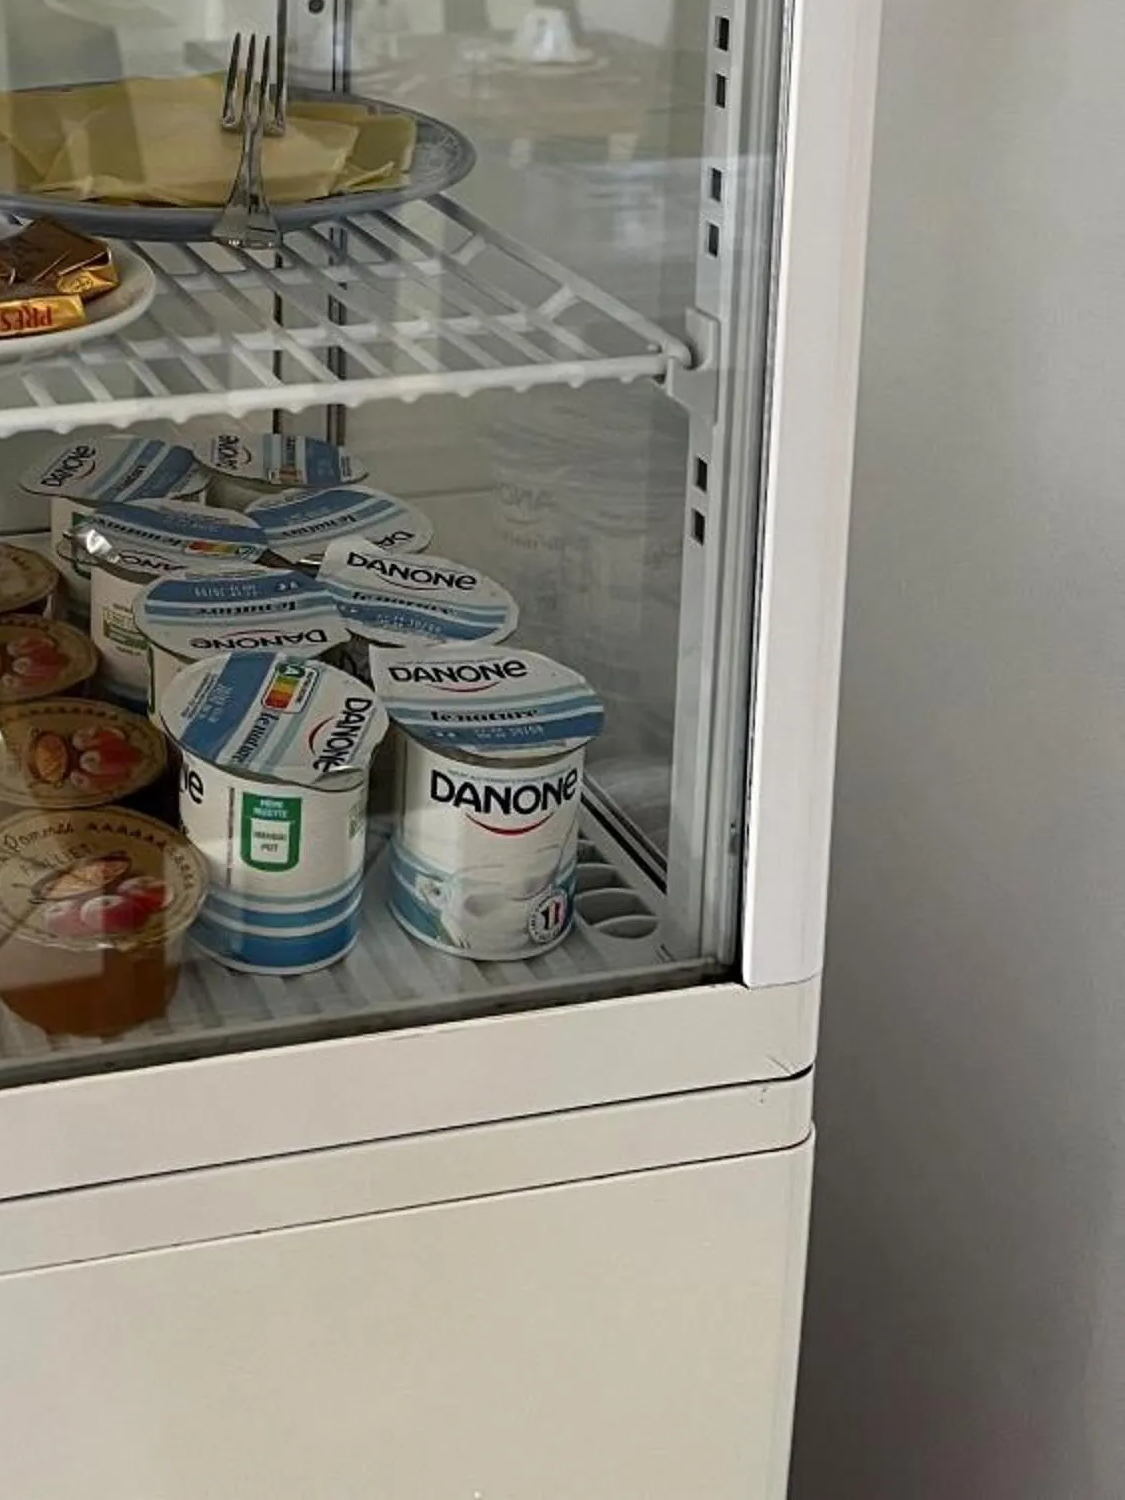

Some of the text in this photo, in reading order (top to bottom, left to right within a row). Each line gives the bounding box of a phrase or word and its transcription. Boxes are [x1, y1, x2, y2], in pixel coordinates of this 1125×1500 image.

[346, 550, 478, 591] DANONE
[190, 629, 328, 650] DANONE
[388, 659, 528, 684] DANONE
[312, 696, 374, 773] DANONE
[429, 767, 578, 816] DANONE
